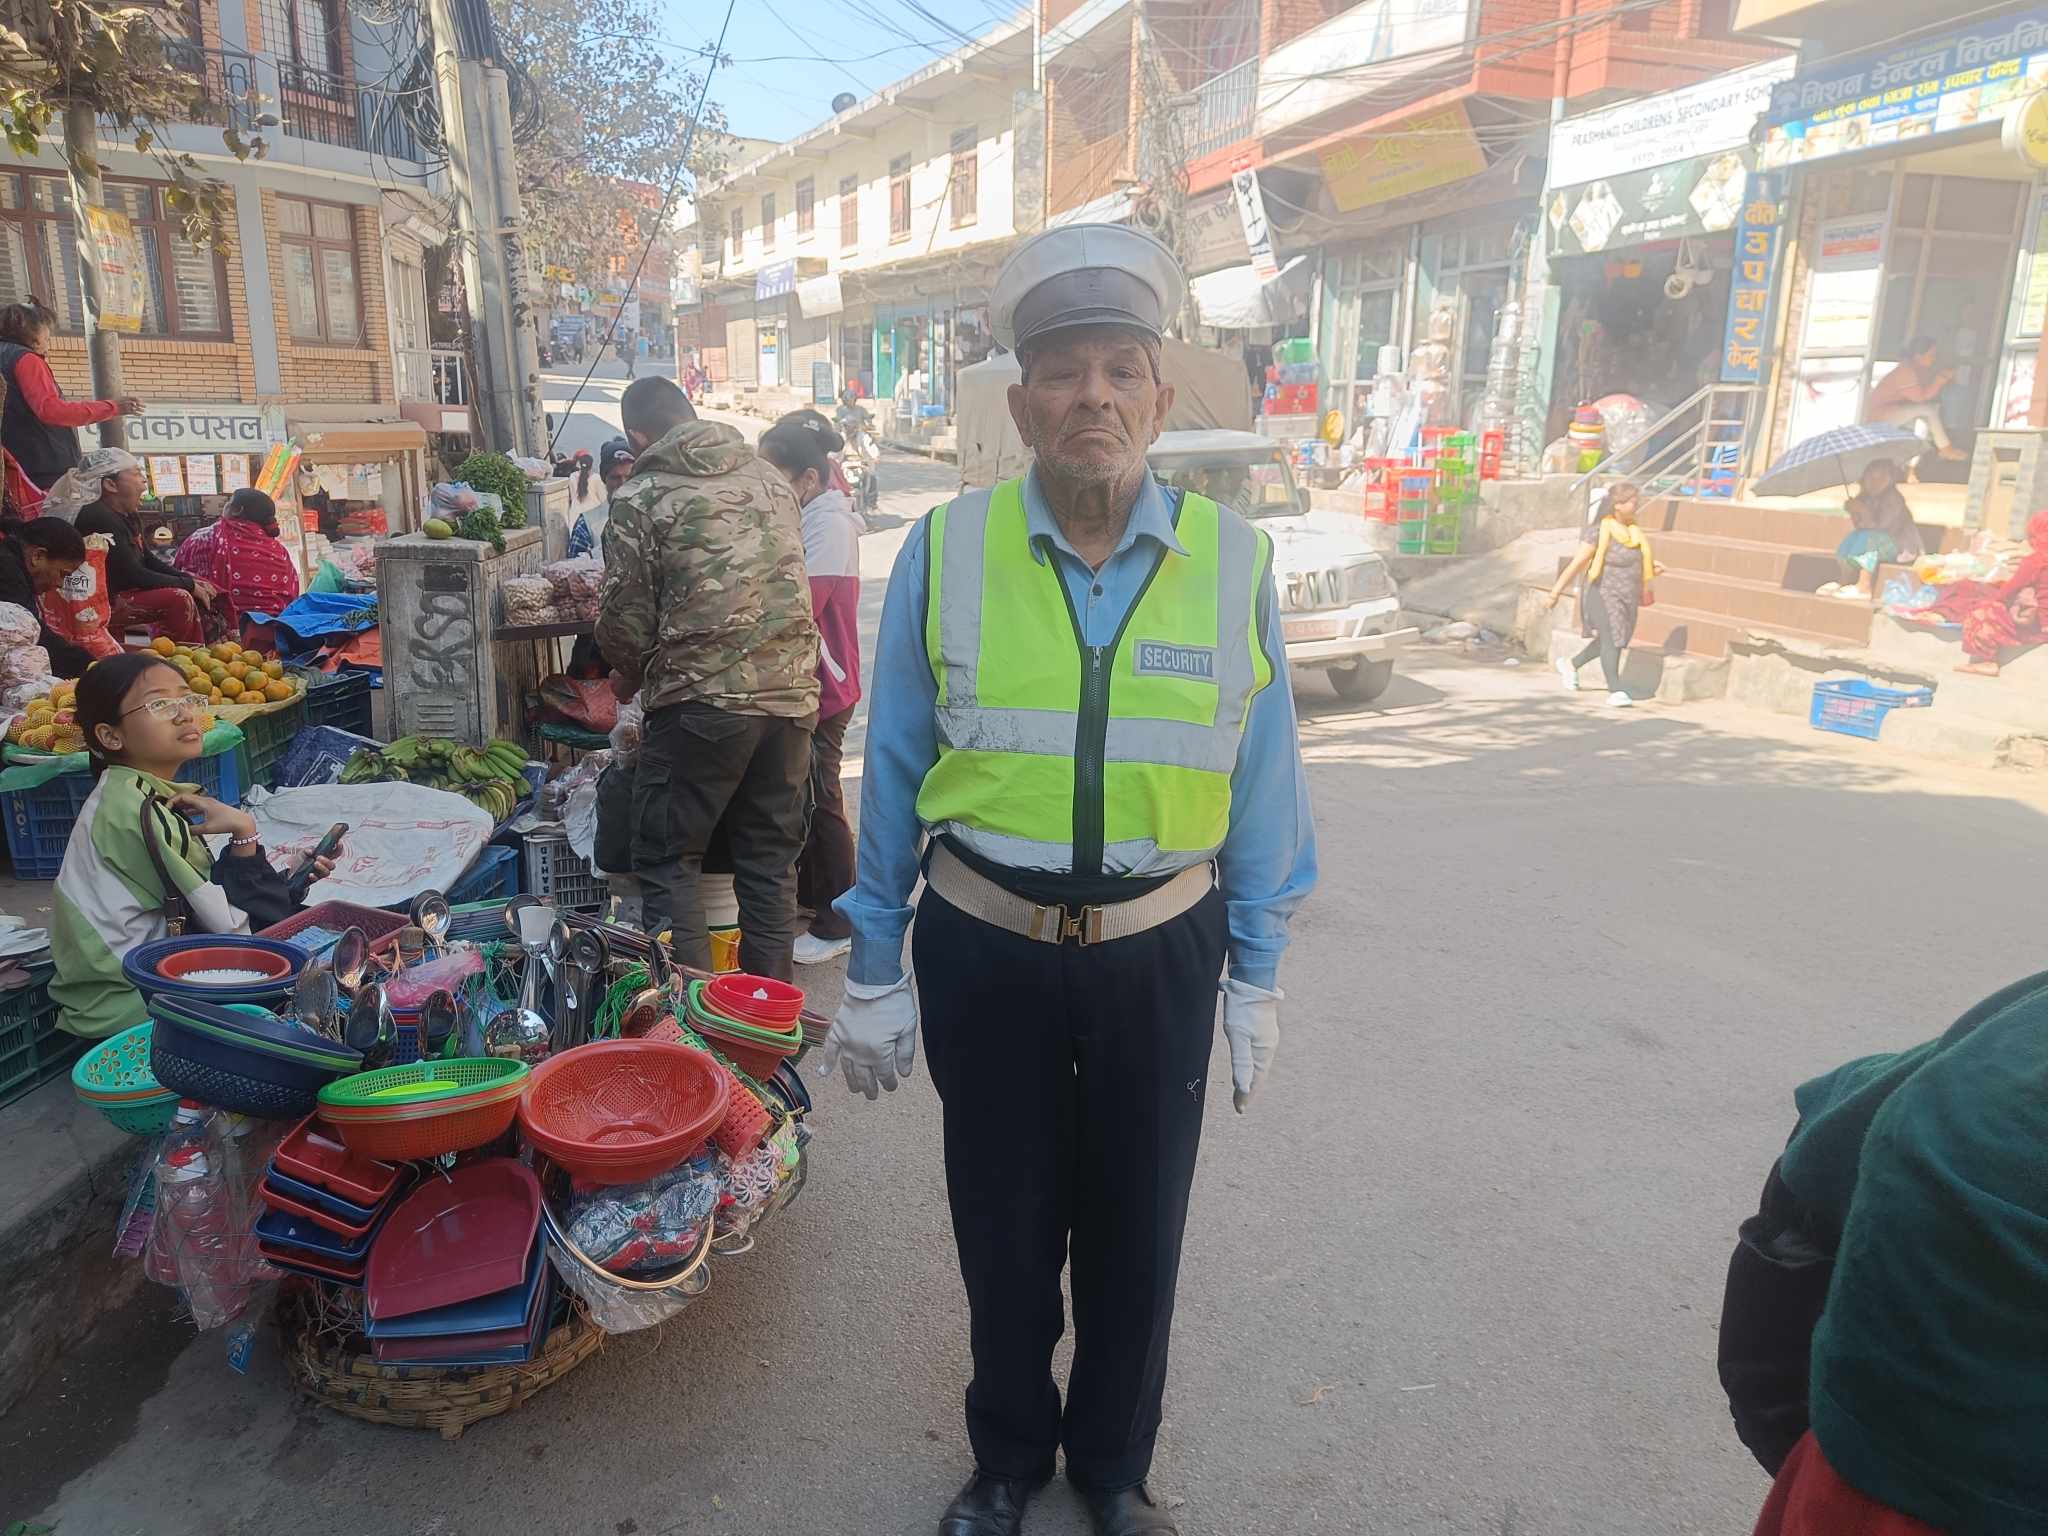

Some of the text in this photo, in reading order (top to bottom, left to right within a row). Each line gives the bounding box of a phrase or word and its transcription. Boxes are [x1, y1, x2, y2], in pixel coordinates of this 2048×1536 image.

[1954, 19, 2048, 70] क्लिनि
[1676, 93, 1741, 123] SECONDARY
[188, 415, 263, 441] पसल
[1144, 647, 1210, 673] SECURITY
